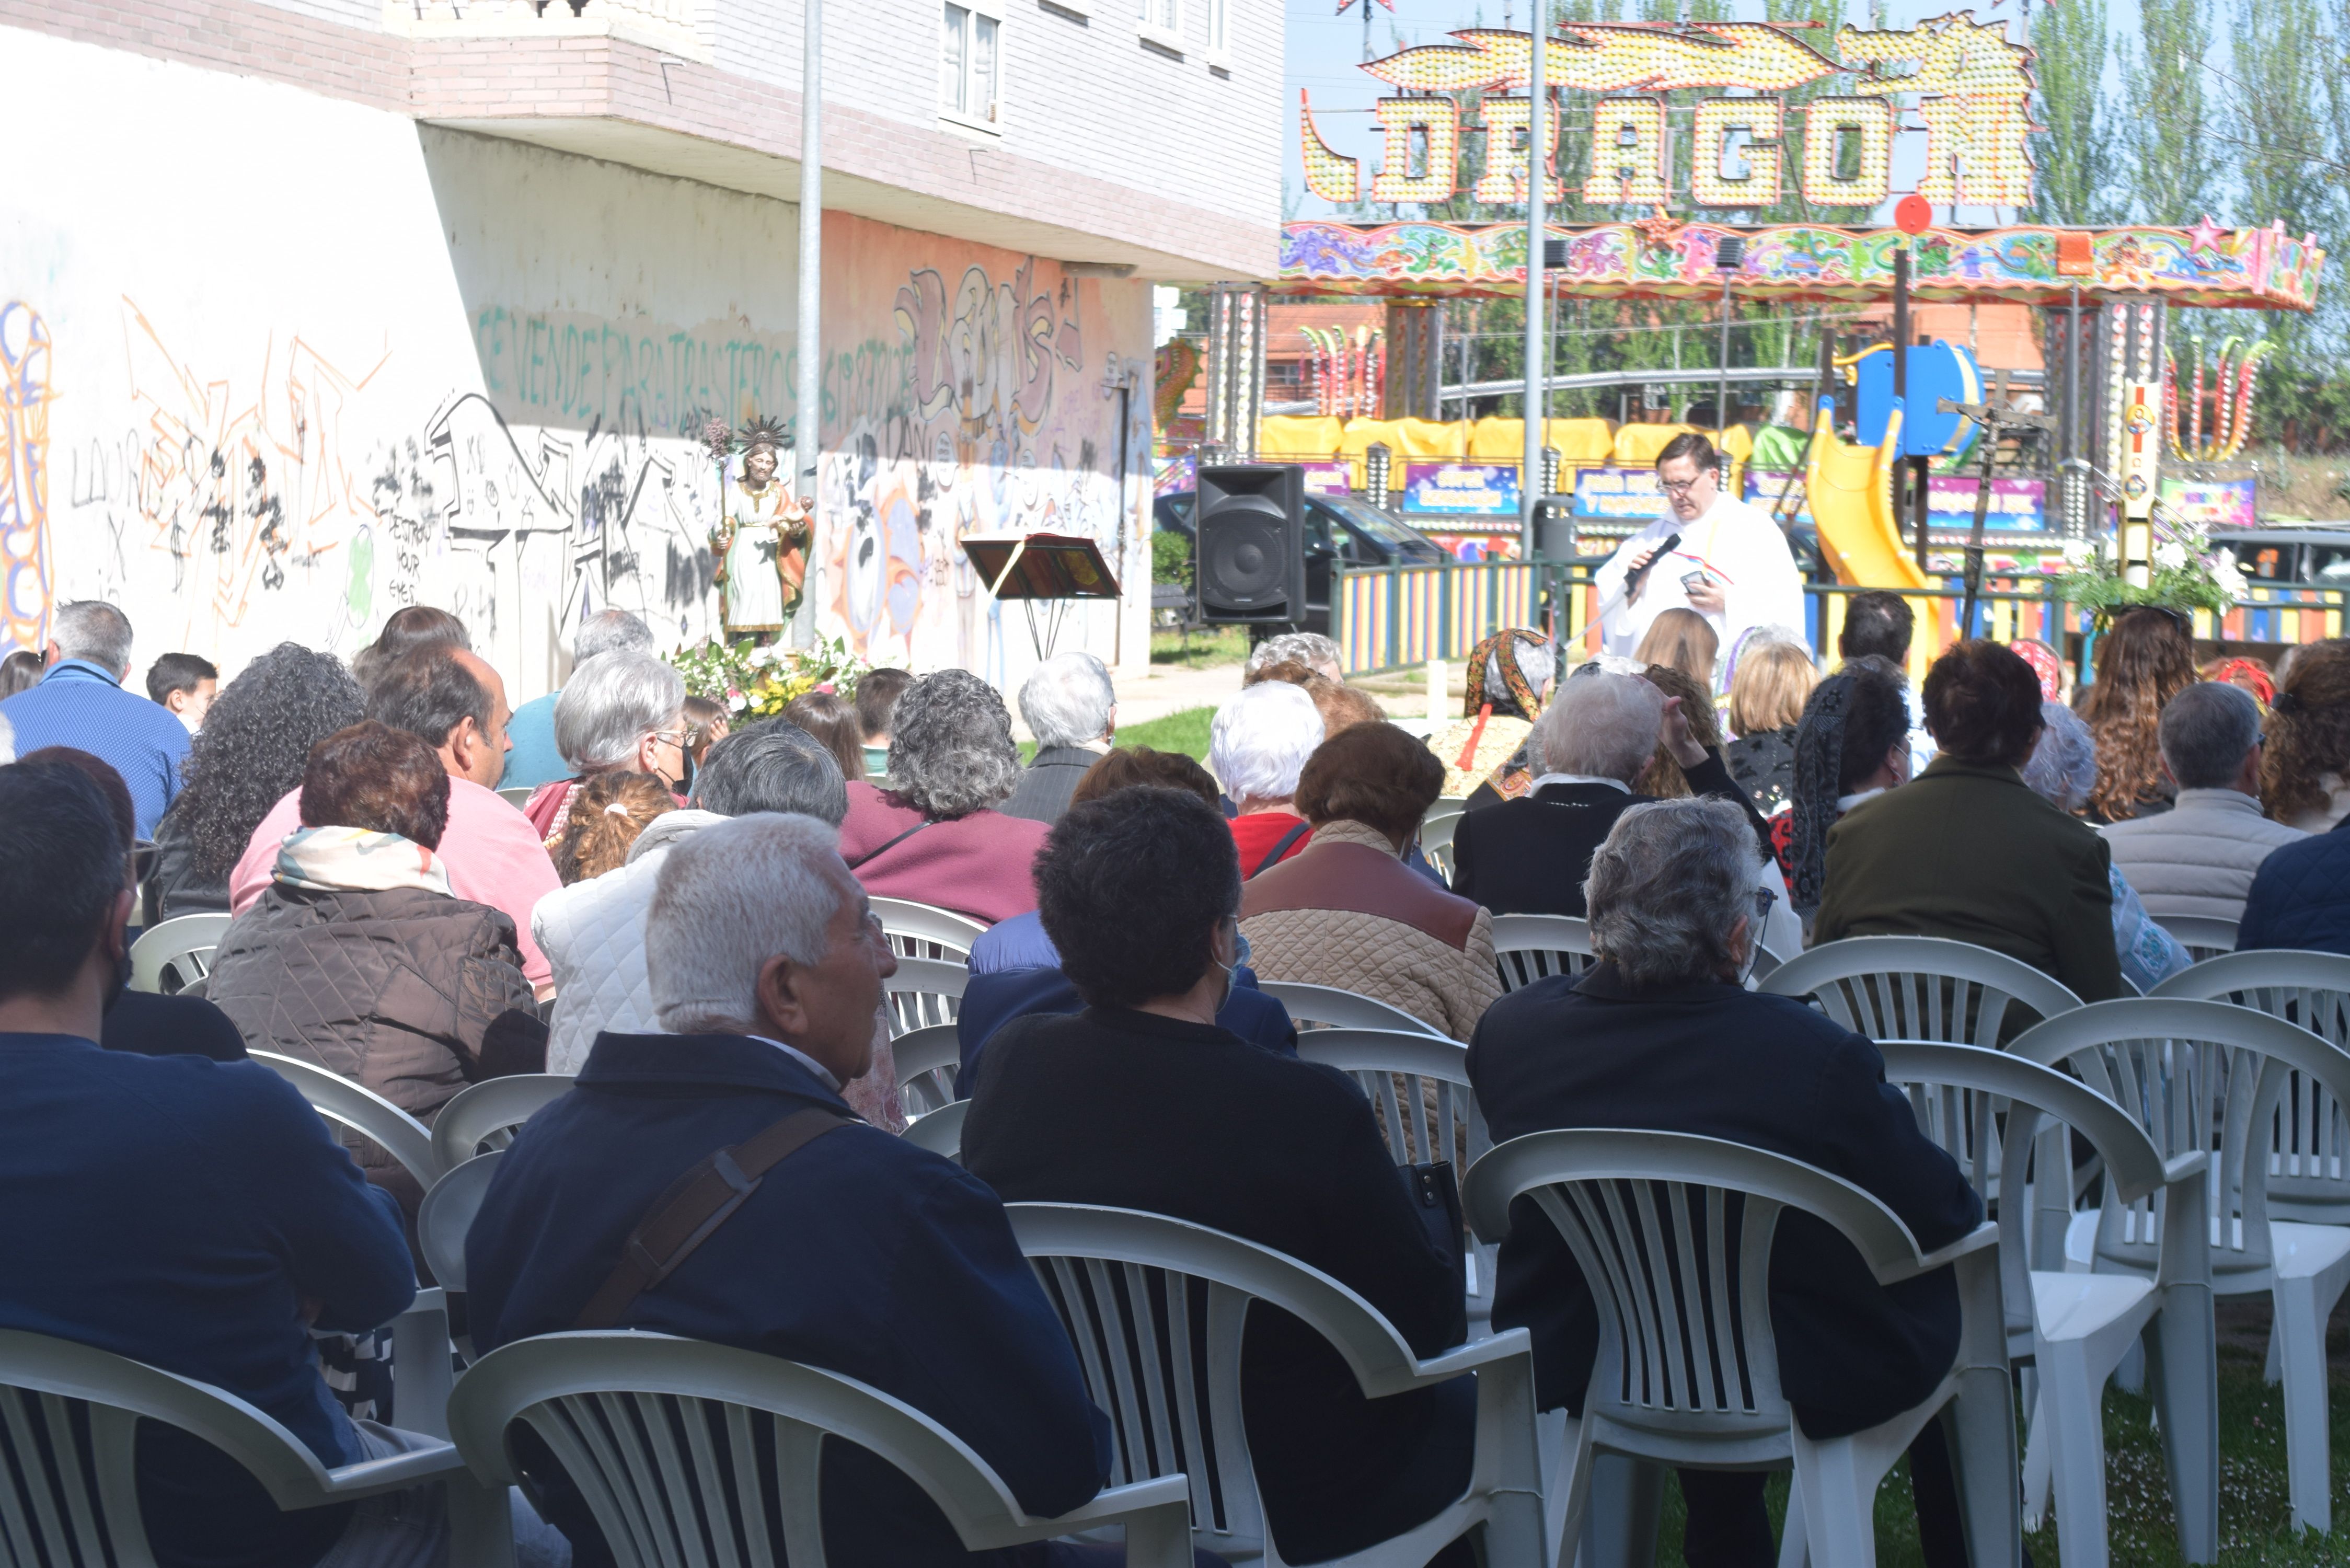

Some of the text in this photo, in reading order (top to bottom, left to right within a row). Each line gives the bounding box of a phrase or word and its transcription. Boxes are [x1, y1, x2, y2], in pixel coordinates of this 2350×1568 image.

[1373, 96, 2035, 206] DRAGON
[511, 316, 597, 419] VENDE
[602, 322, 670, 431] PARA
[1437, 471, 1485, 488] SUPER
[1583, 472, 1667, 494] PARA NIÑ
[1420, 488, 1502, 508] SENSACIÓN
[1586, 497, 1598, 513] Y
[396, 544, 421, 583] YOUR
